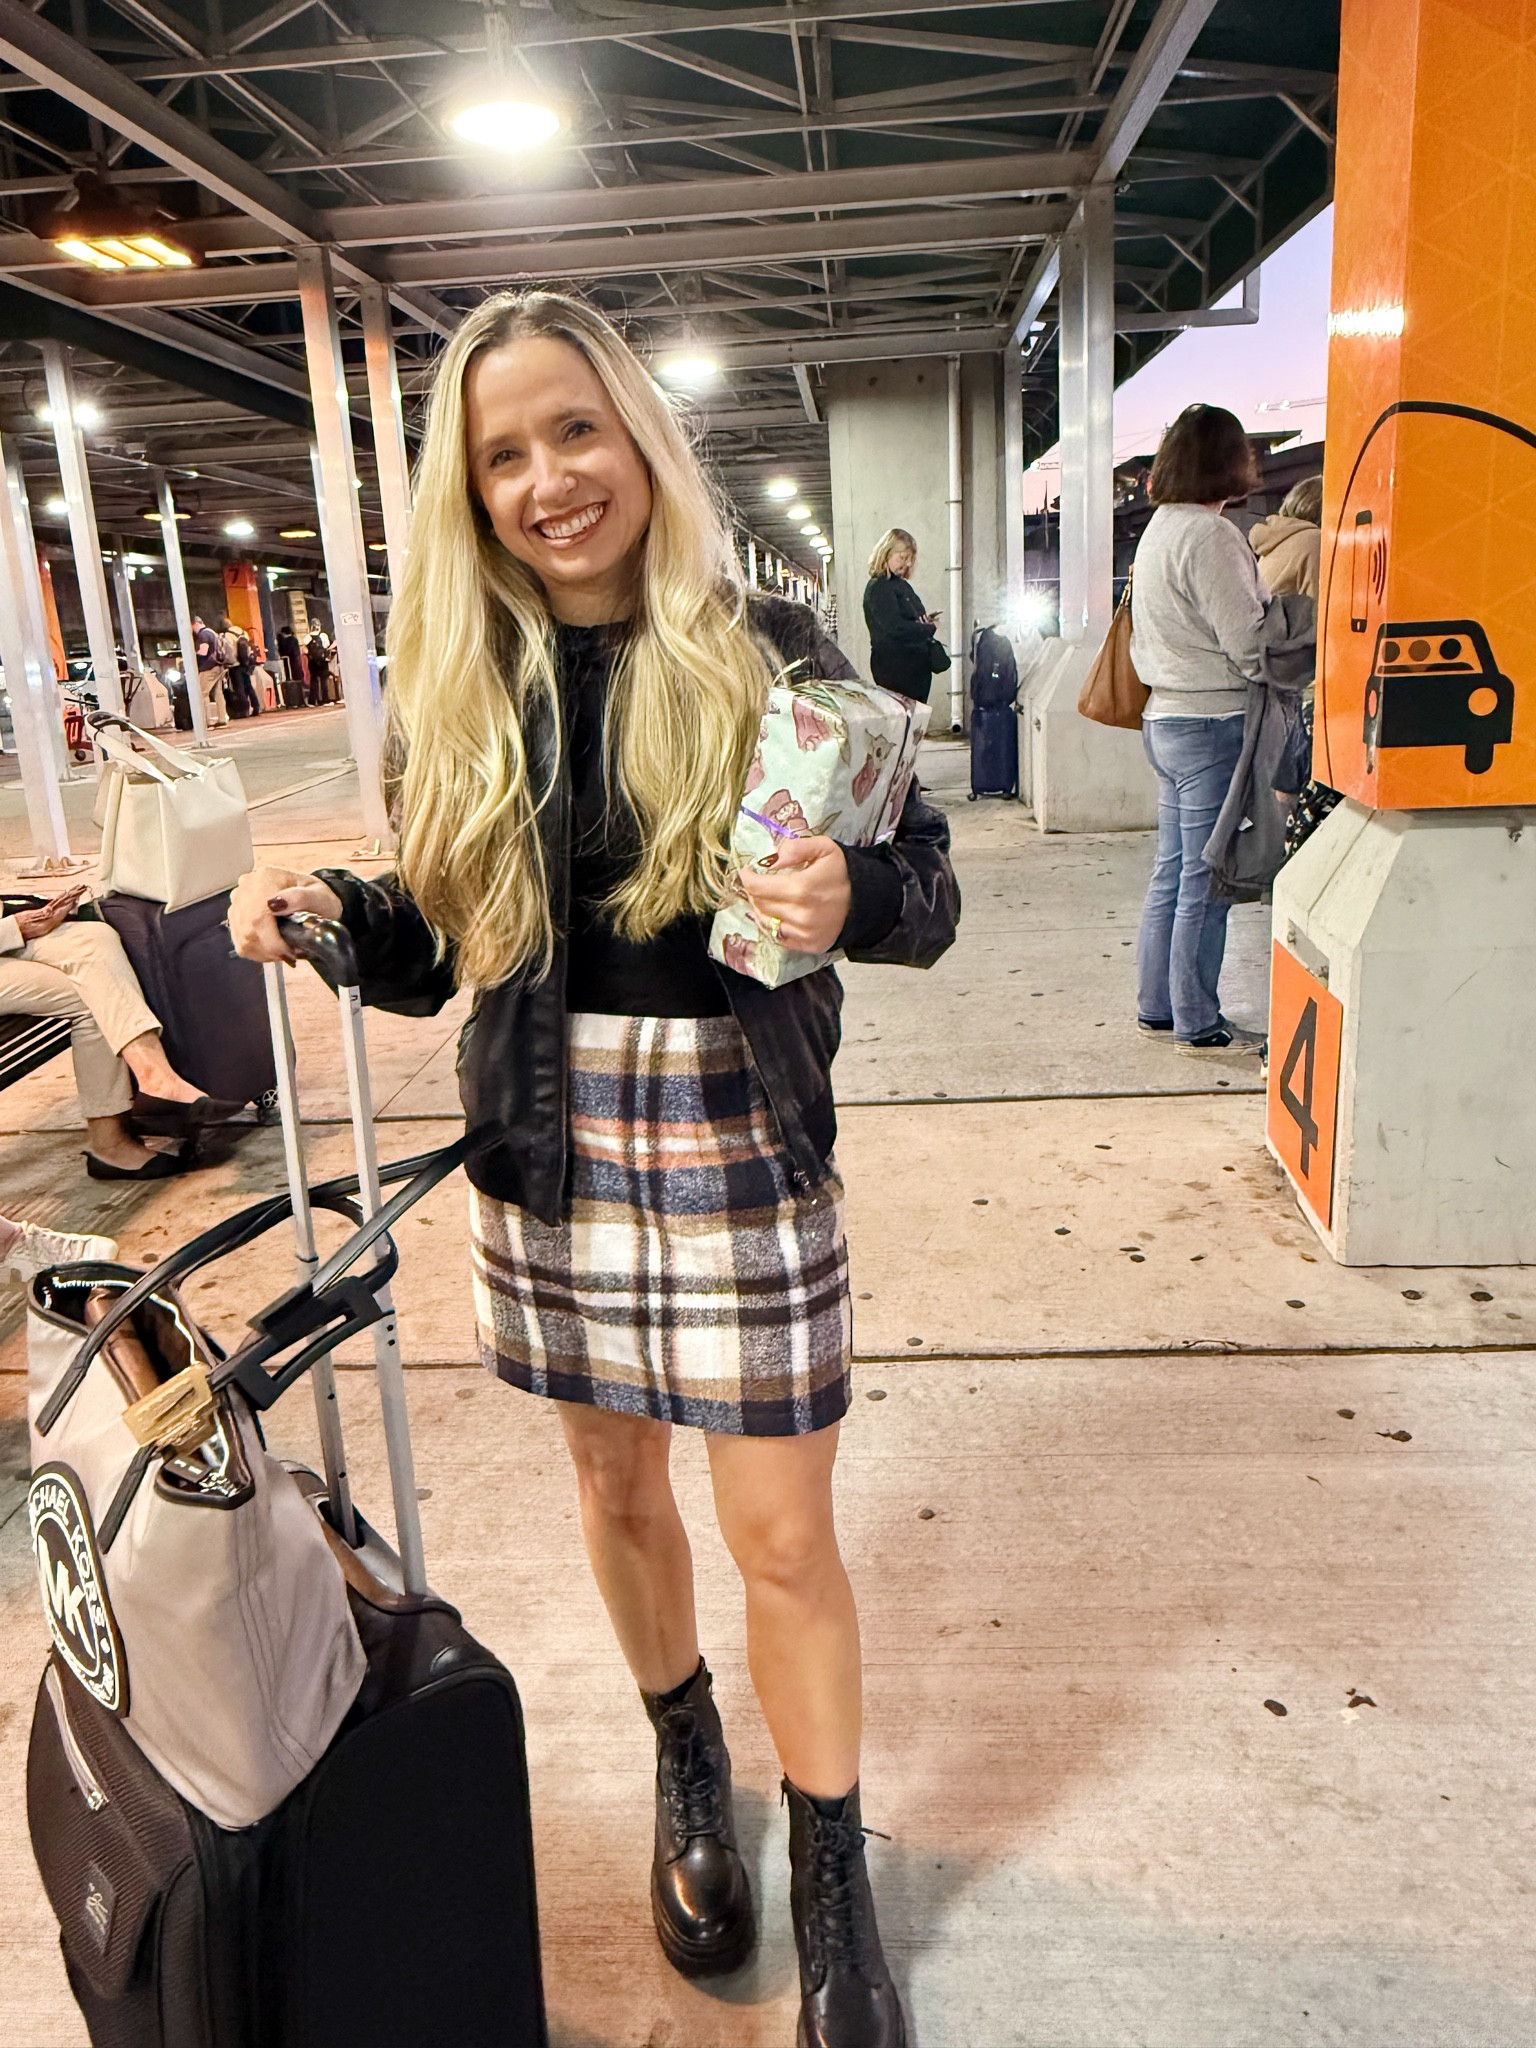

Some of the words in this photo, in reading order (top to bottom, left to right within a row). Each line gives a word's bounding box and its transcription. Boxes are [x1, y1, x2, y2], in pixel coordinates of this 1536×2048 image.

[229, 569, 239, 584] 7
[266, 687, 273, 706] 7
[1280, 997, 1318, 1180] 4
[37, 1533, 96, 1660] MK
[70, 1524, 105, 1628] KORS
